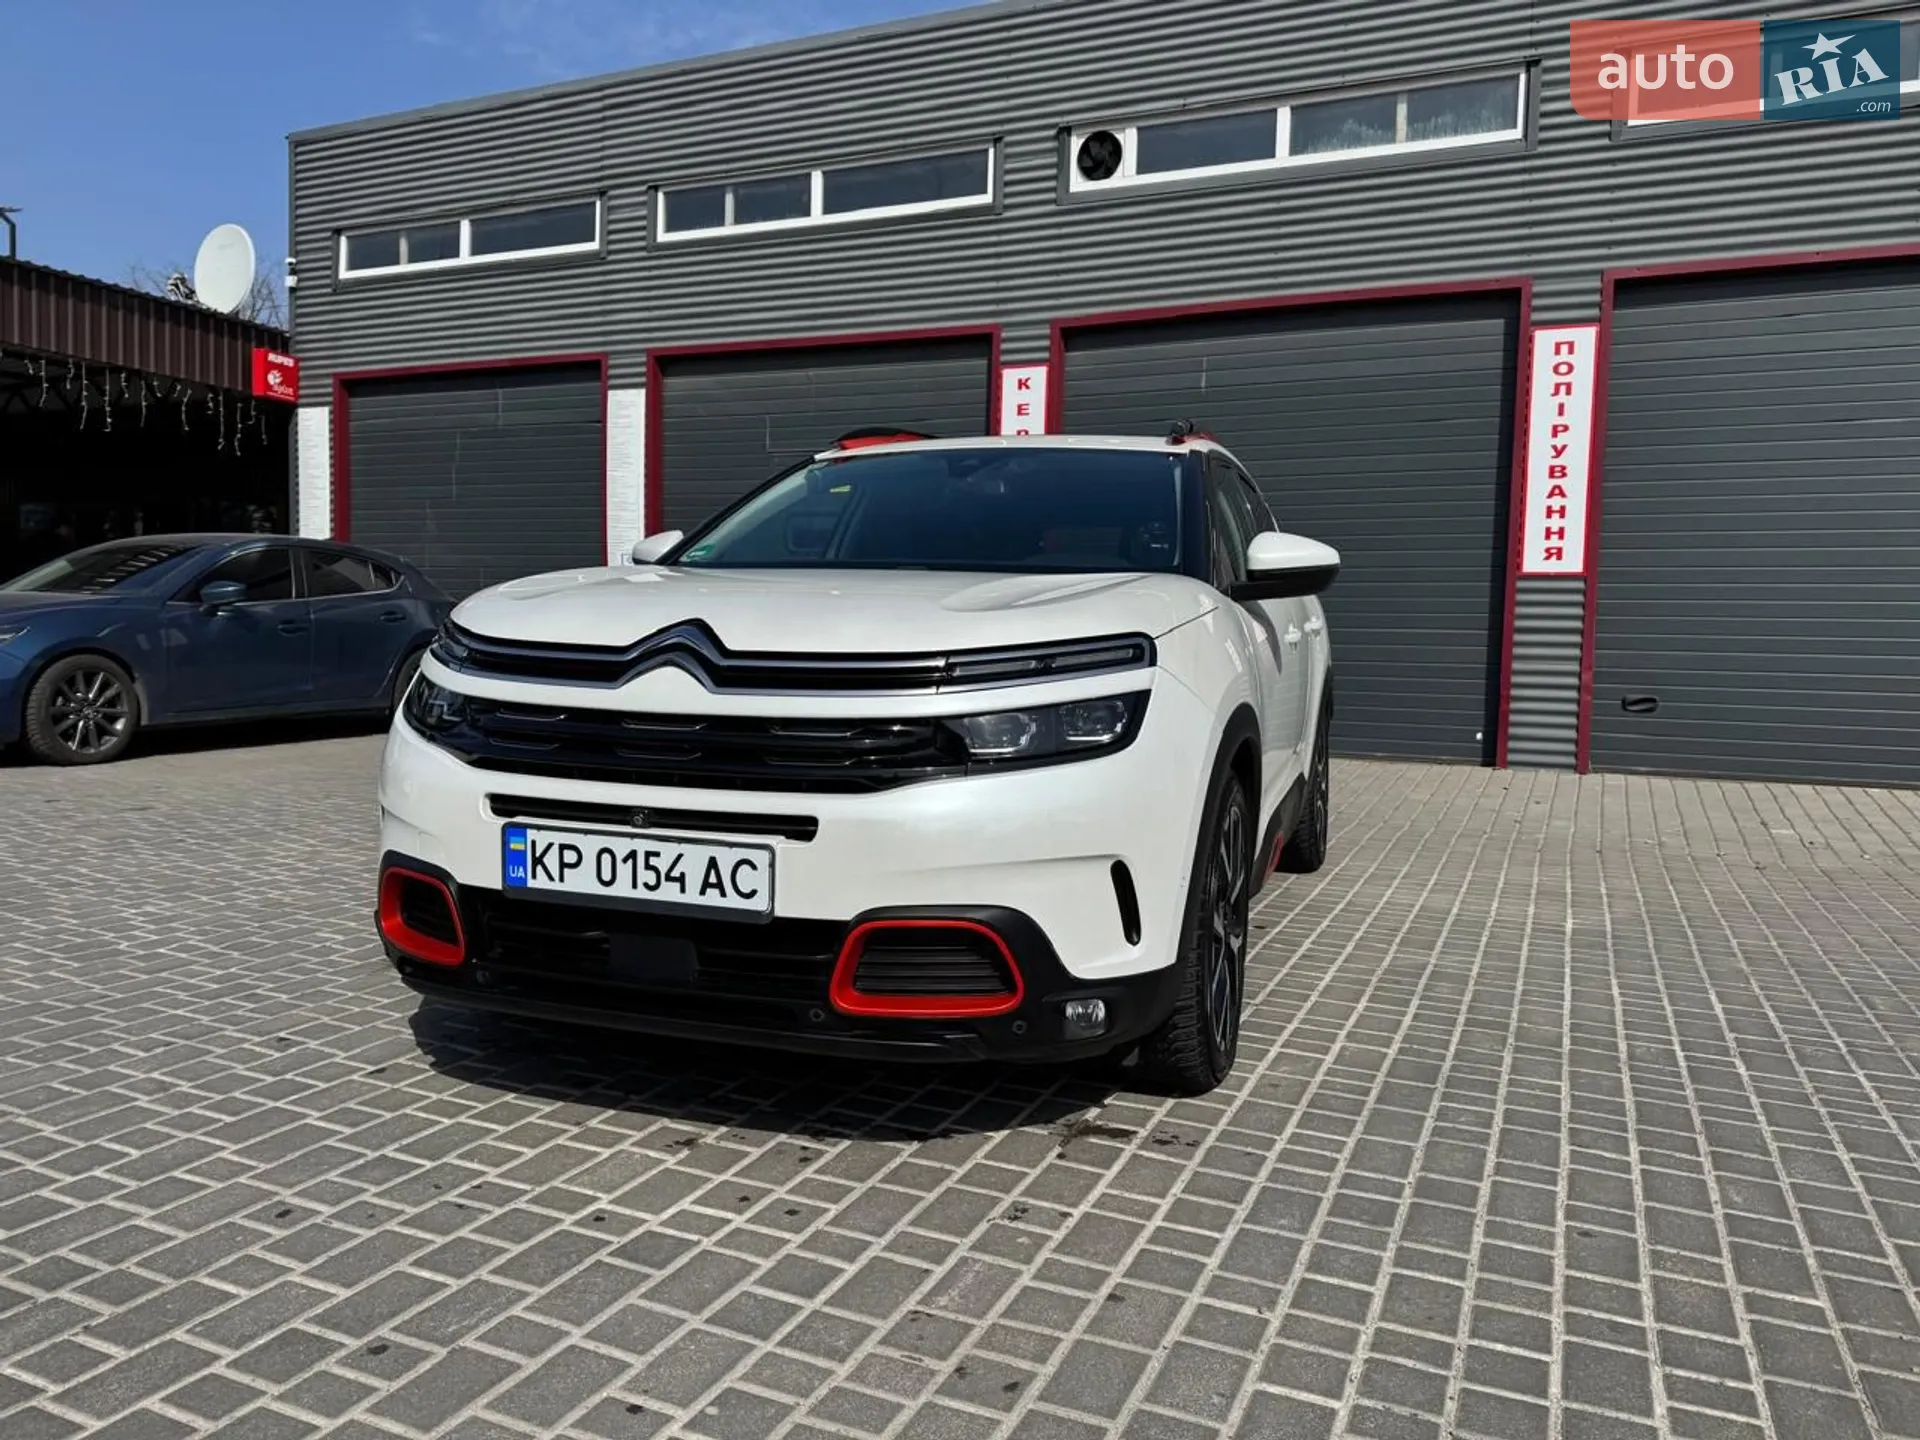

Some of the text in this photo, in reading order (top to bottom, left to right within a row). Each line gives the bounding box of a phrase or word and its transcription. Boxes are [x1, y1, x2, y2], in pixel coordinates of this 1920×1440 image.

[1543, 340, 1576, 561] ПОЛІРУВАННЯ
[509, 839, 758, 900] UA KP 0154 AC
